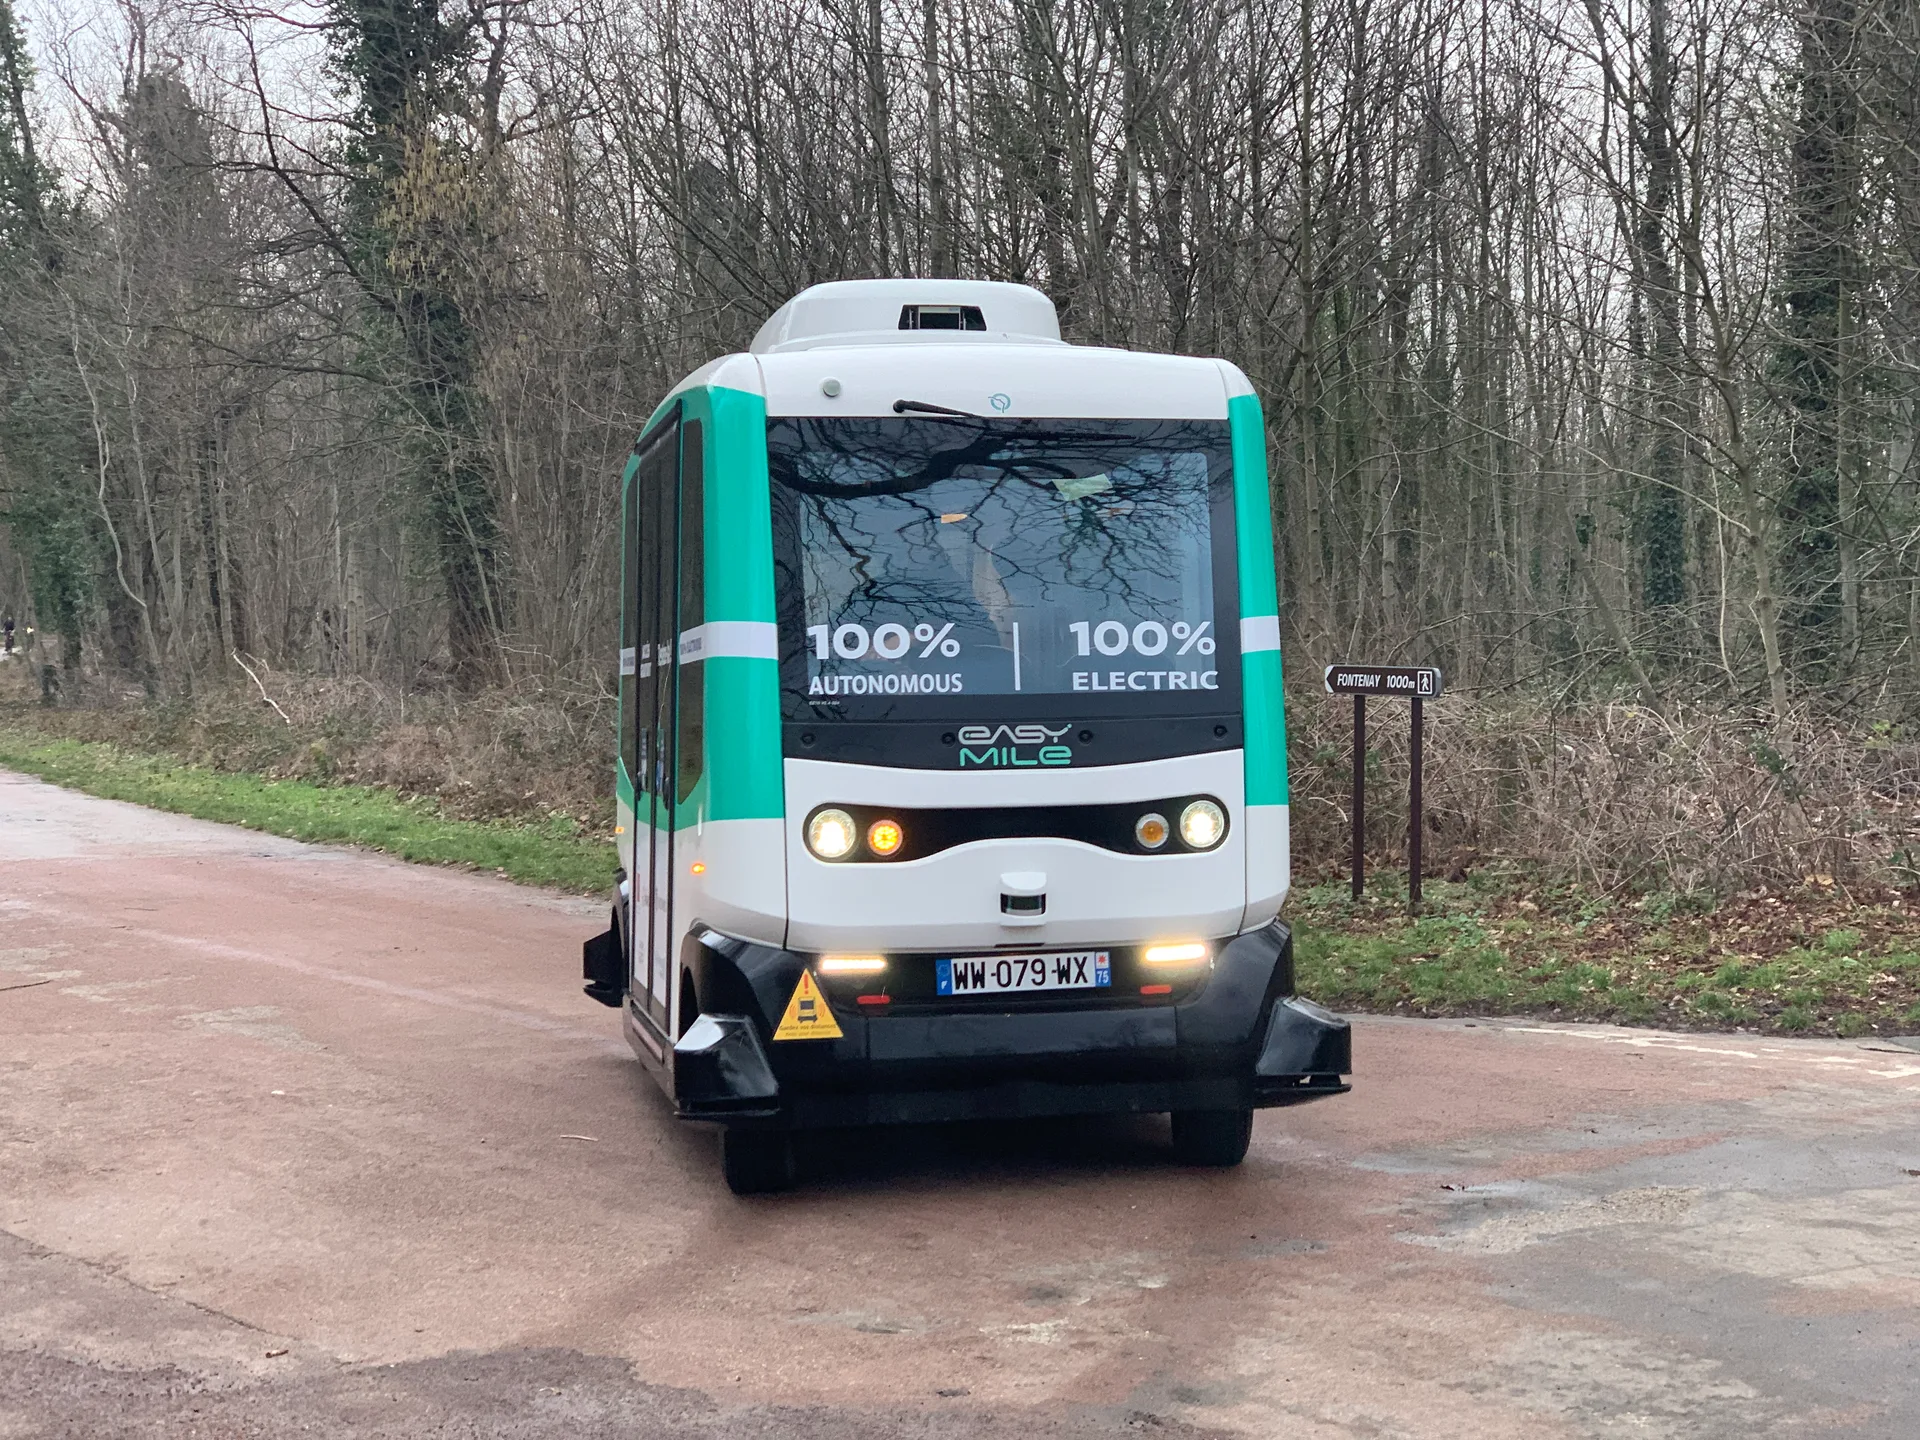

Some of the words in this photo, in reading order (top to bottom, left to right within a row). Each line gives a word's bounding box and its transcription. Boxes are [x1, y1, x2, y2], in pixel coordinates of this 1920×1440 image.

[807, 622, 961, 660] 100%
[1069, 620, 1217, 657] 100%
[808, 673, 963, 696] AUTONOMOUS
[1072, 670, 1220, 691] ELECTRIC
[1337, 673, 1382, 688] FONTENAY
[1386, 674, 1415, 689] 1000m
[1096, 969, 1109, 984] 75
